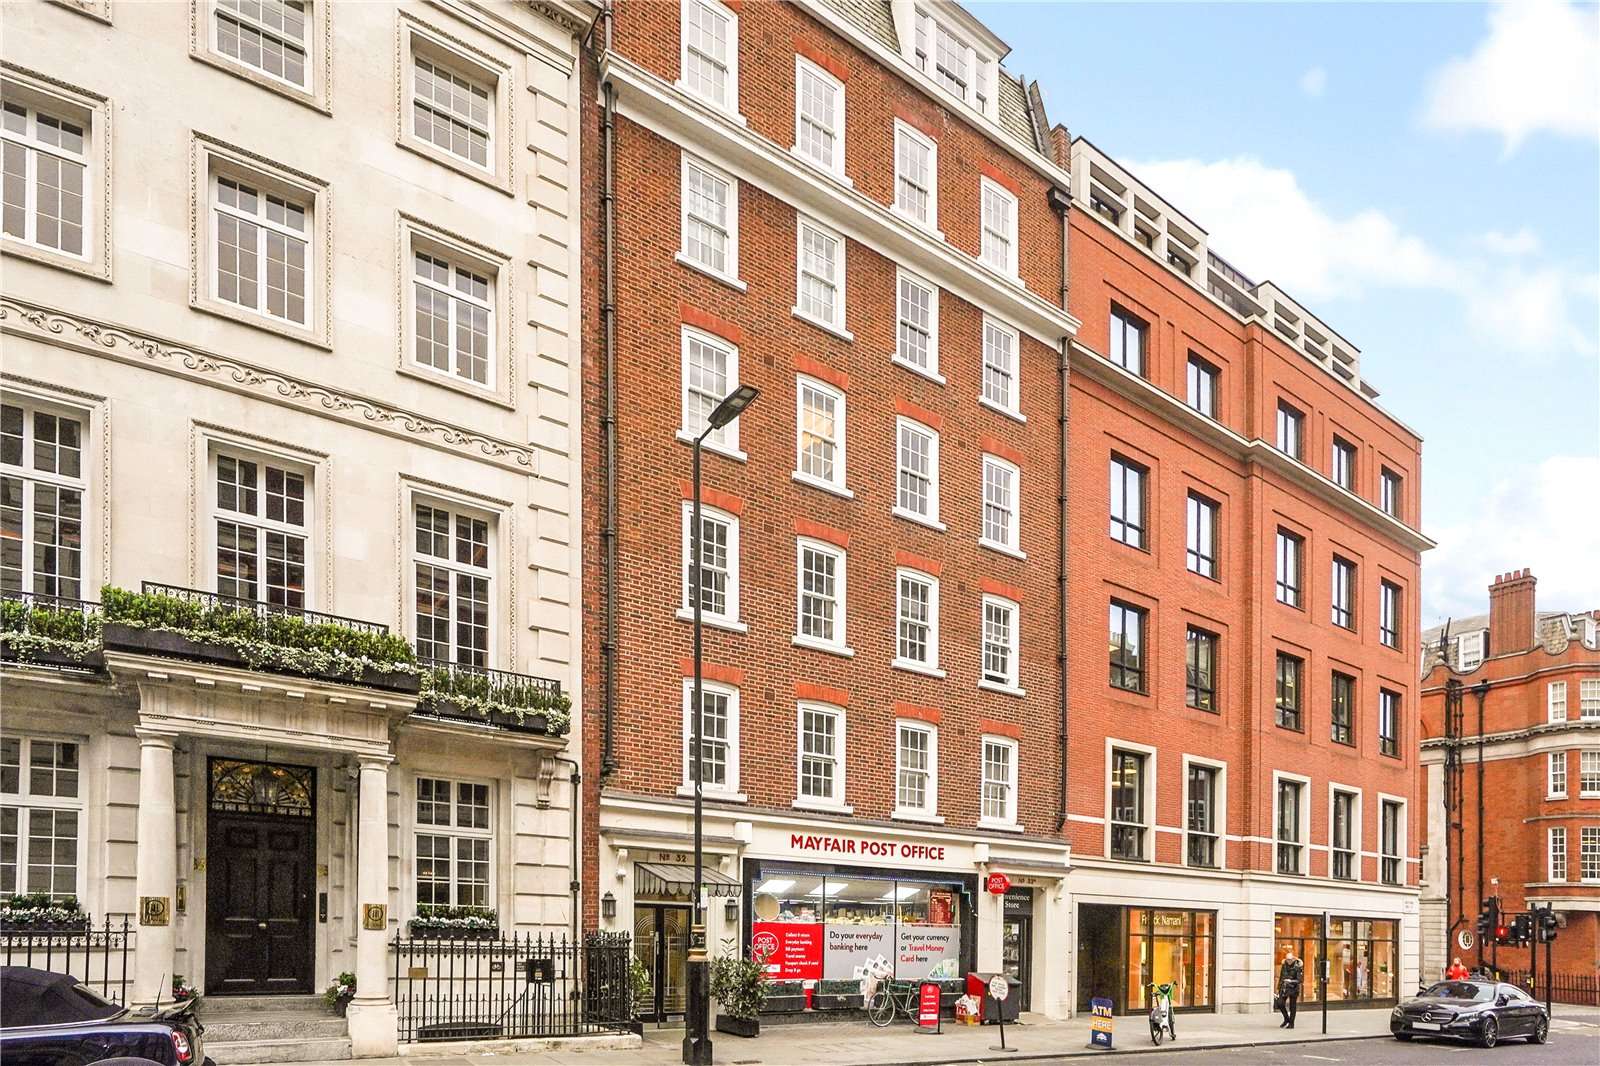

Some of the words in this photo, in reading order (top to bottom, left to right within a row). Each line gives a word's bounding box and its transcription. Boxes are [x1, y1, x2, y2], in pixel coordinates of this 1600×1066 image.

[791, 834, 856, 853] MAYFAIR
[861, 841, 897, 856] POST
[901, 844, 945, 860] OFFICE
[676, 854, 687, 862] 32
[829, 931, 840, 939] Do
[841, 933, 855, 941] your
[855, 931, 884, 942] everyday
[900, 932, 912, 941] Get
[912, 934, 925, 942] your
[926, 935, 950, 943] currency
[829, 942, 854, 952] banking
[854, 942, 868, 951] here
[908, 943, 925, 952] Travel
[925, 944, 945, 953] Money
[900, 954, 915, 963] Card
[915, 954, 928, 963] here
[1091, 1004, 1112, 1017] ATM
[1091, 1019, 1112, 1031] HERE
